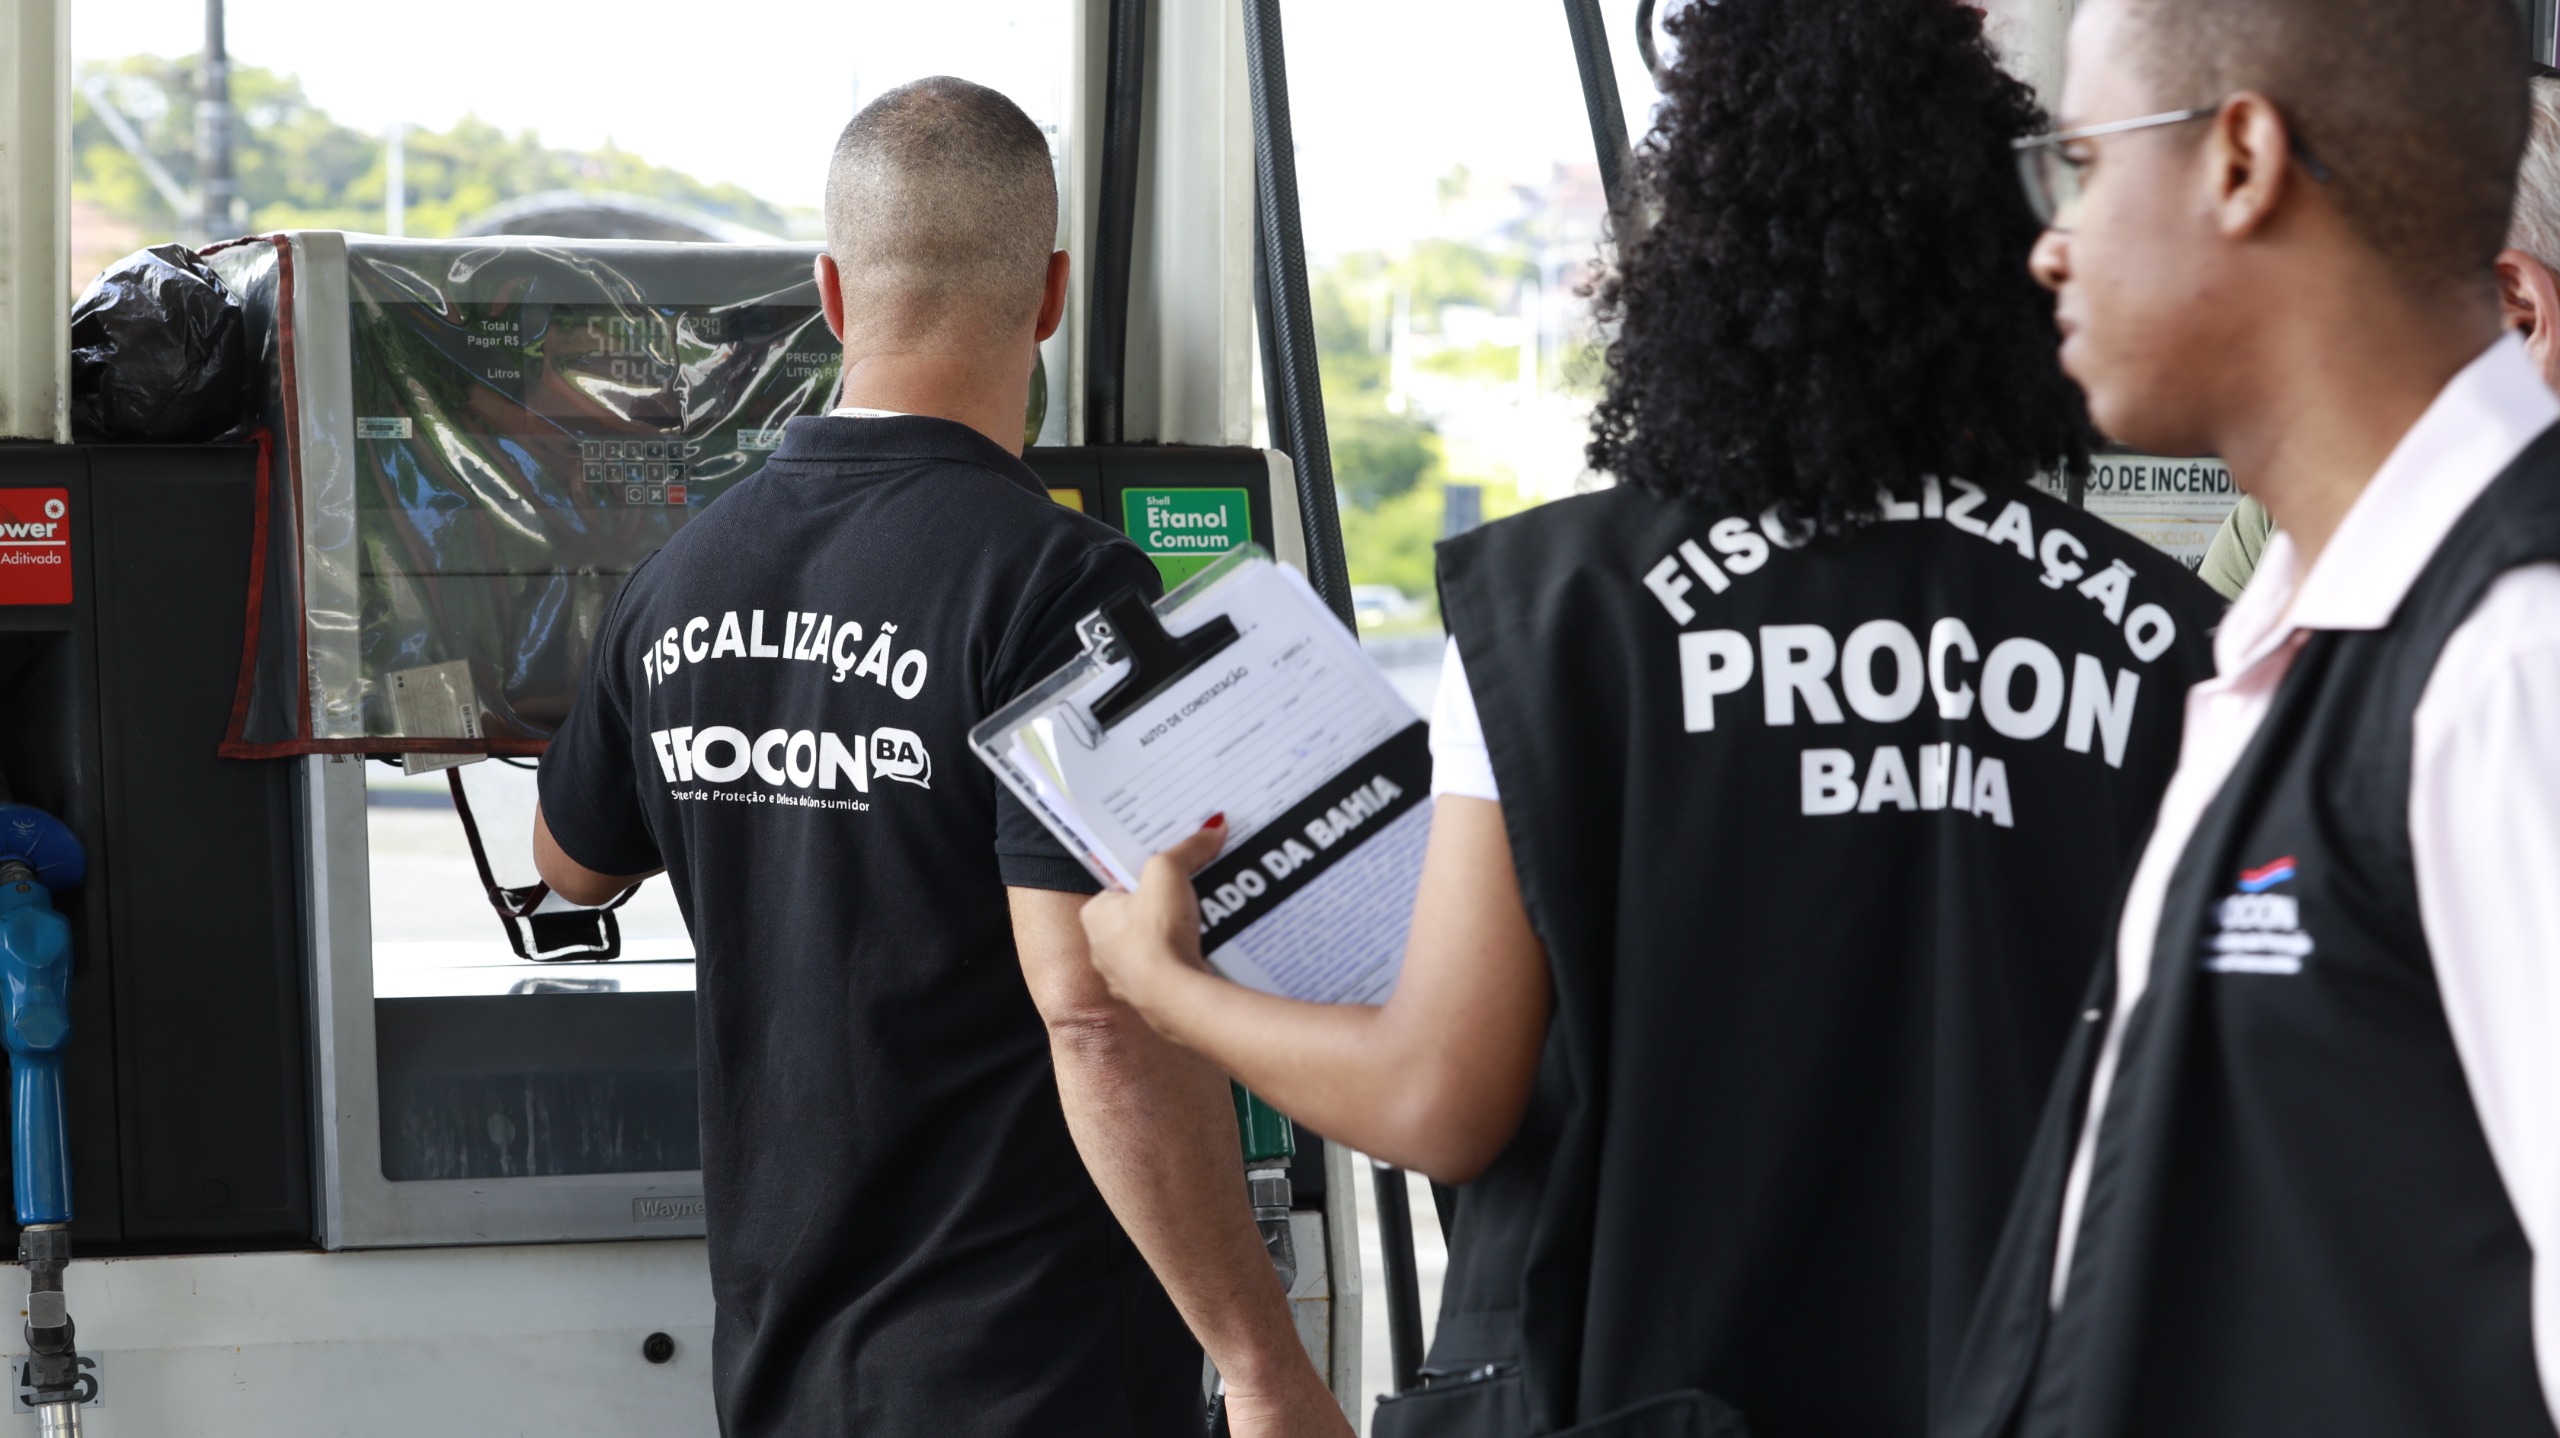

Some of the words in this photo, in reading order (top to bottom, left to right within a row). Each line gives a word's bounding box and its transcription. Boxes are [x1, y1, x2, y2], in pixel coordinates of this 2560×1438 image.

[481, 320, 509, 331] Total
[512, 322, 519, 331] a
[467, 335, 501, 348] Pagar
[504, 335, 519, 347] R$
[786, 352, 827, 365] PREÇO
[487, 368, 520, 379] Litros
[786, 367, 821, 378] LITRO
[610, 446, 616, 454] 2
[651, 446, 657, 454] 4
[672, 446, 678, 454] 5
[589, 468, 596, 476] 6
[610, 468, 616, 476] 7
[652, 468, 658, 476] 9
[673, 468, 679, 476] 0
[2048, 464, 2115, 490] RICO
[2119, 466, 2147, 491] DE
[1146, 496, 1171, 505] Shell
[1147, 505, 1227, 528] Etanol
[1149, 530, 1229, 548] Comum
[0, 550, 61, 565] Aditivada
[1643, 475, 2176, 663] FISCLIZAÇÃO
[642, 609, 928, 700] FISCALIZAÇÃO
[1678, 617, 2140, 769] PROCON
[1139, 723, 1168, 747] AUTO
[1166, 713, 1183, 728] DE
[1181, 666, 1249, 717] CONSTATAÇÃO
[876, 738, 919, 765] BA
[1800, 741, 2014, 828] BAHIA
[695, 788, 708, 801] de
[713, 790, 766, 805] Proteção
[769, 794, 775, 804] e
[1200, 869, 1267, 934] ADO
[1260, 838, 1315, 881] DA
[1303, 774, 1403, 851] BAHIA
[640, 1200, 706, 1219] Wayne
